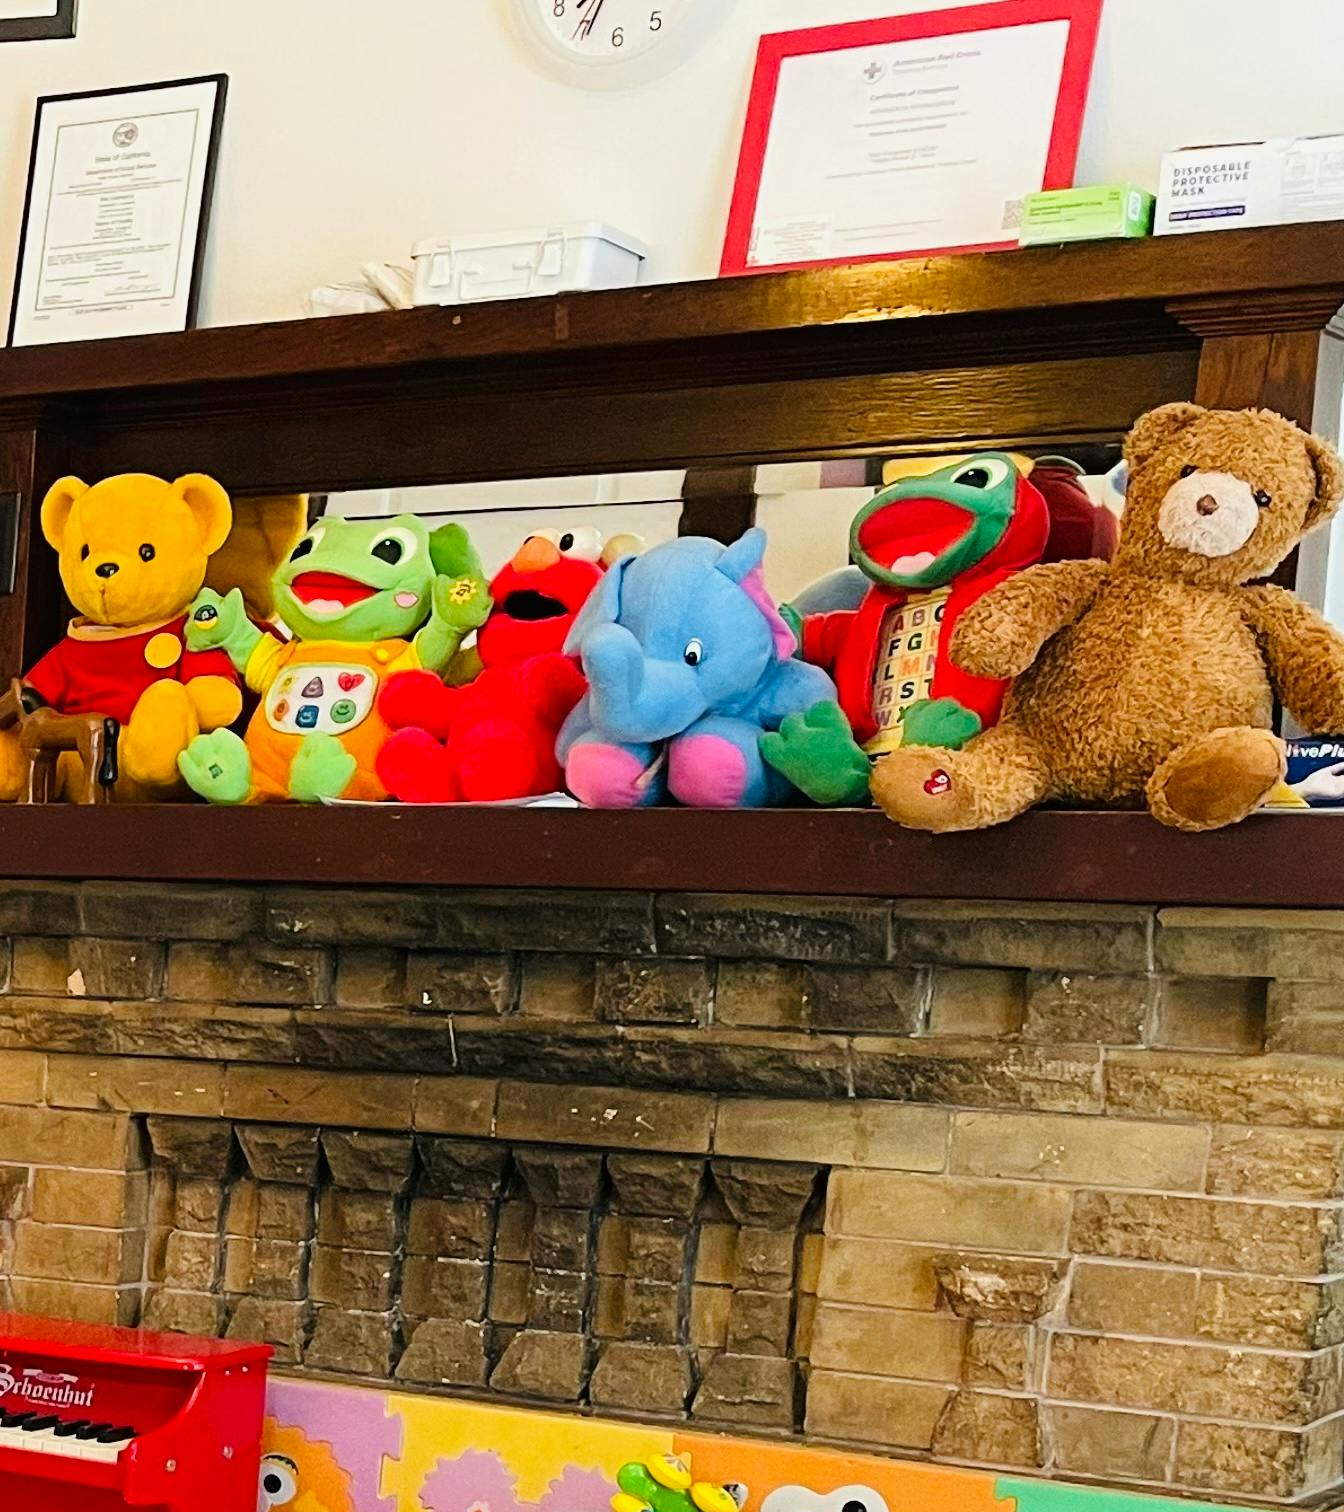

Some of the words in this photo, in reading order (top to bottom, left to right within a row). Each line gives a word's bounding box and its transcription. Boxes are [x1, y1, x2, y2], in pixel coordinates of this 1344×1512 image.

[649, 10, 662, 31] 5
[611, 26, 624, 47] 6
[1174, 160, 1251, 178] DISPOSABLE
[1172, 171, 1250, 187] PROTECTIVE
[1171, 187, 1205, 198] MASK
[892, 614, 904, 635] A
[912, 608, 926, 627] B
[888, 638, 901, 658] F
[907, 632, 923, 652] G
[883, 663, 894, 681] L
[900, 681, 915, 699] S
